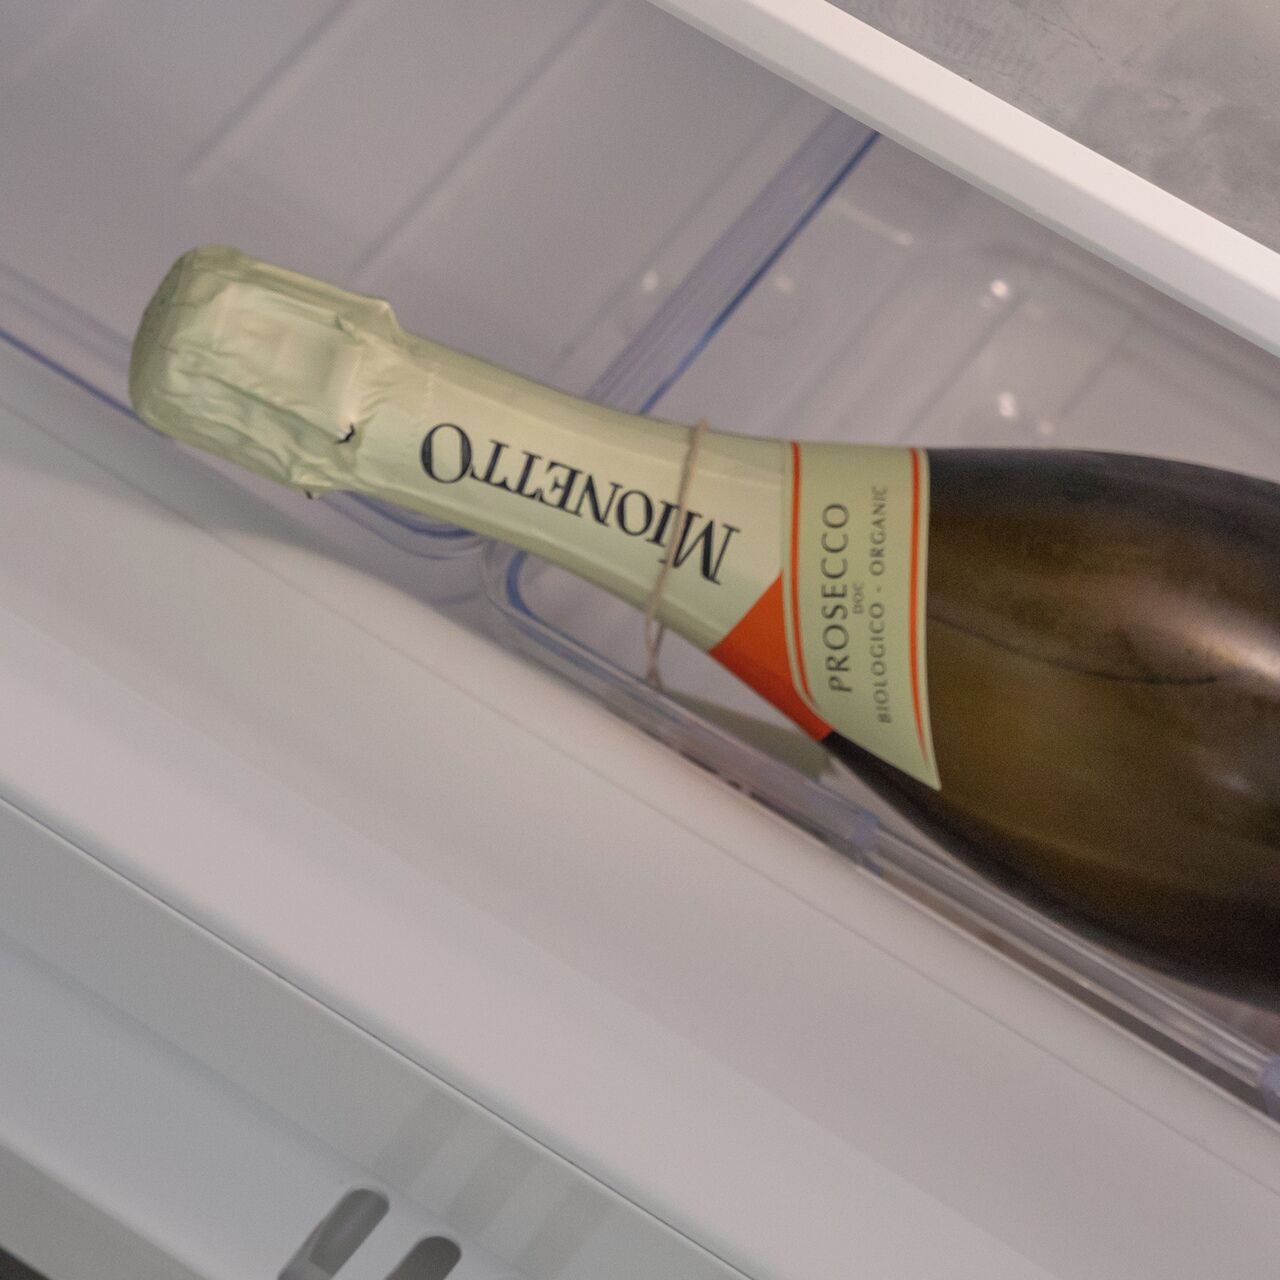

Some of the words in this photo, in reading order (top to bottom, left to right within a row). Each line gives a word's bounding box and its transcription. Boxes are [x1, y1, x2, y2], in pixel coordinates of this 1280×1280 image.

[421, 423, 741, 586] MIONETTO
[870, 486, 888, 576] ORGANIC
[821, 503, 853, 692] PROSECCO
[869, 602, 892, 724] BIOLOGICO
